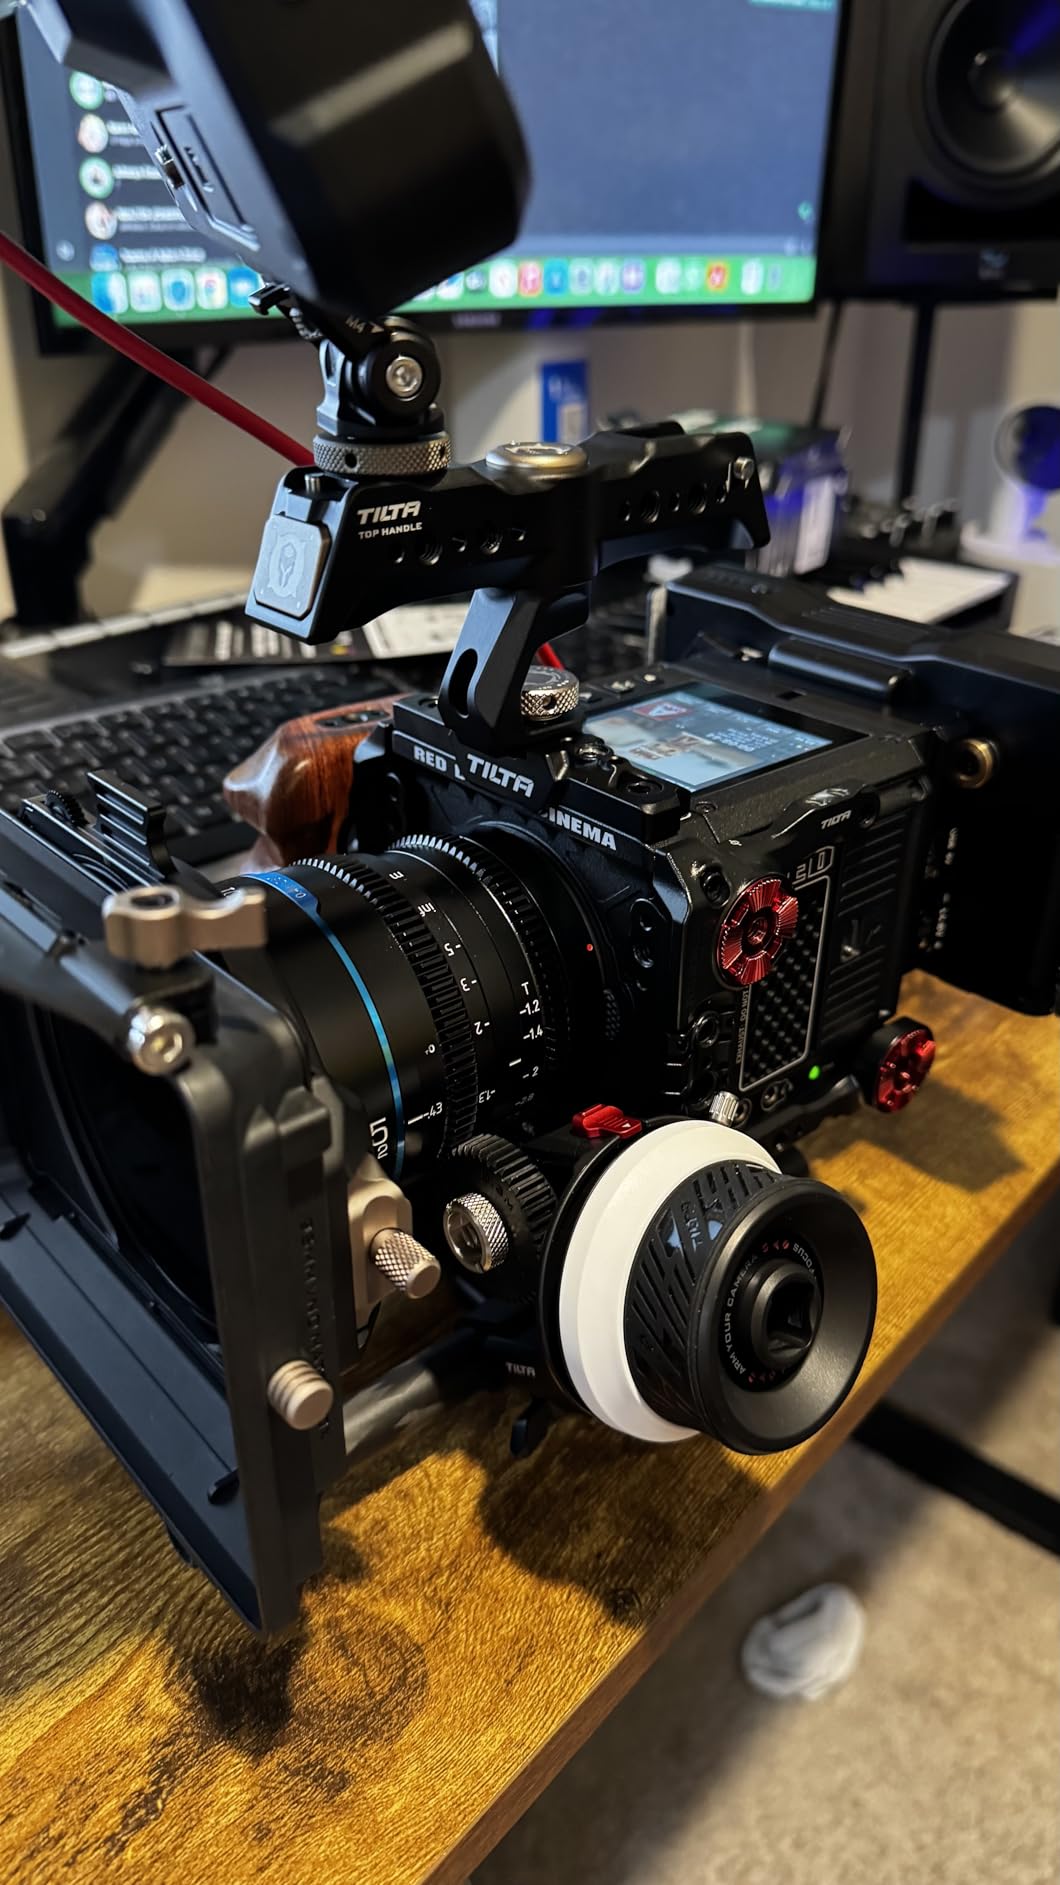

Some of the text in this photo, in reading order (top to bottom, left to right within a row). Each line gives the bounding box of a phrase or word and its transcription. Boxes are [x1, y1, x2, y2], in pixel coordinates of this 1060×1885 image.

[357, 500, 422, 525] TILTA
[358, 521, 423, 540] TOP HANDLE
[466, 753, 535, 798] TILTA
[413, 745, 617, 851] RED INEMA
[417, 902, 437, 917] inf
[520, 981, 529, 996] T
[724, 1254, 759, 1375] ARM YOUR CAMERA
[505, 1361, 536, 1377] TILTA
